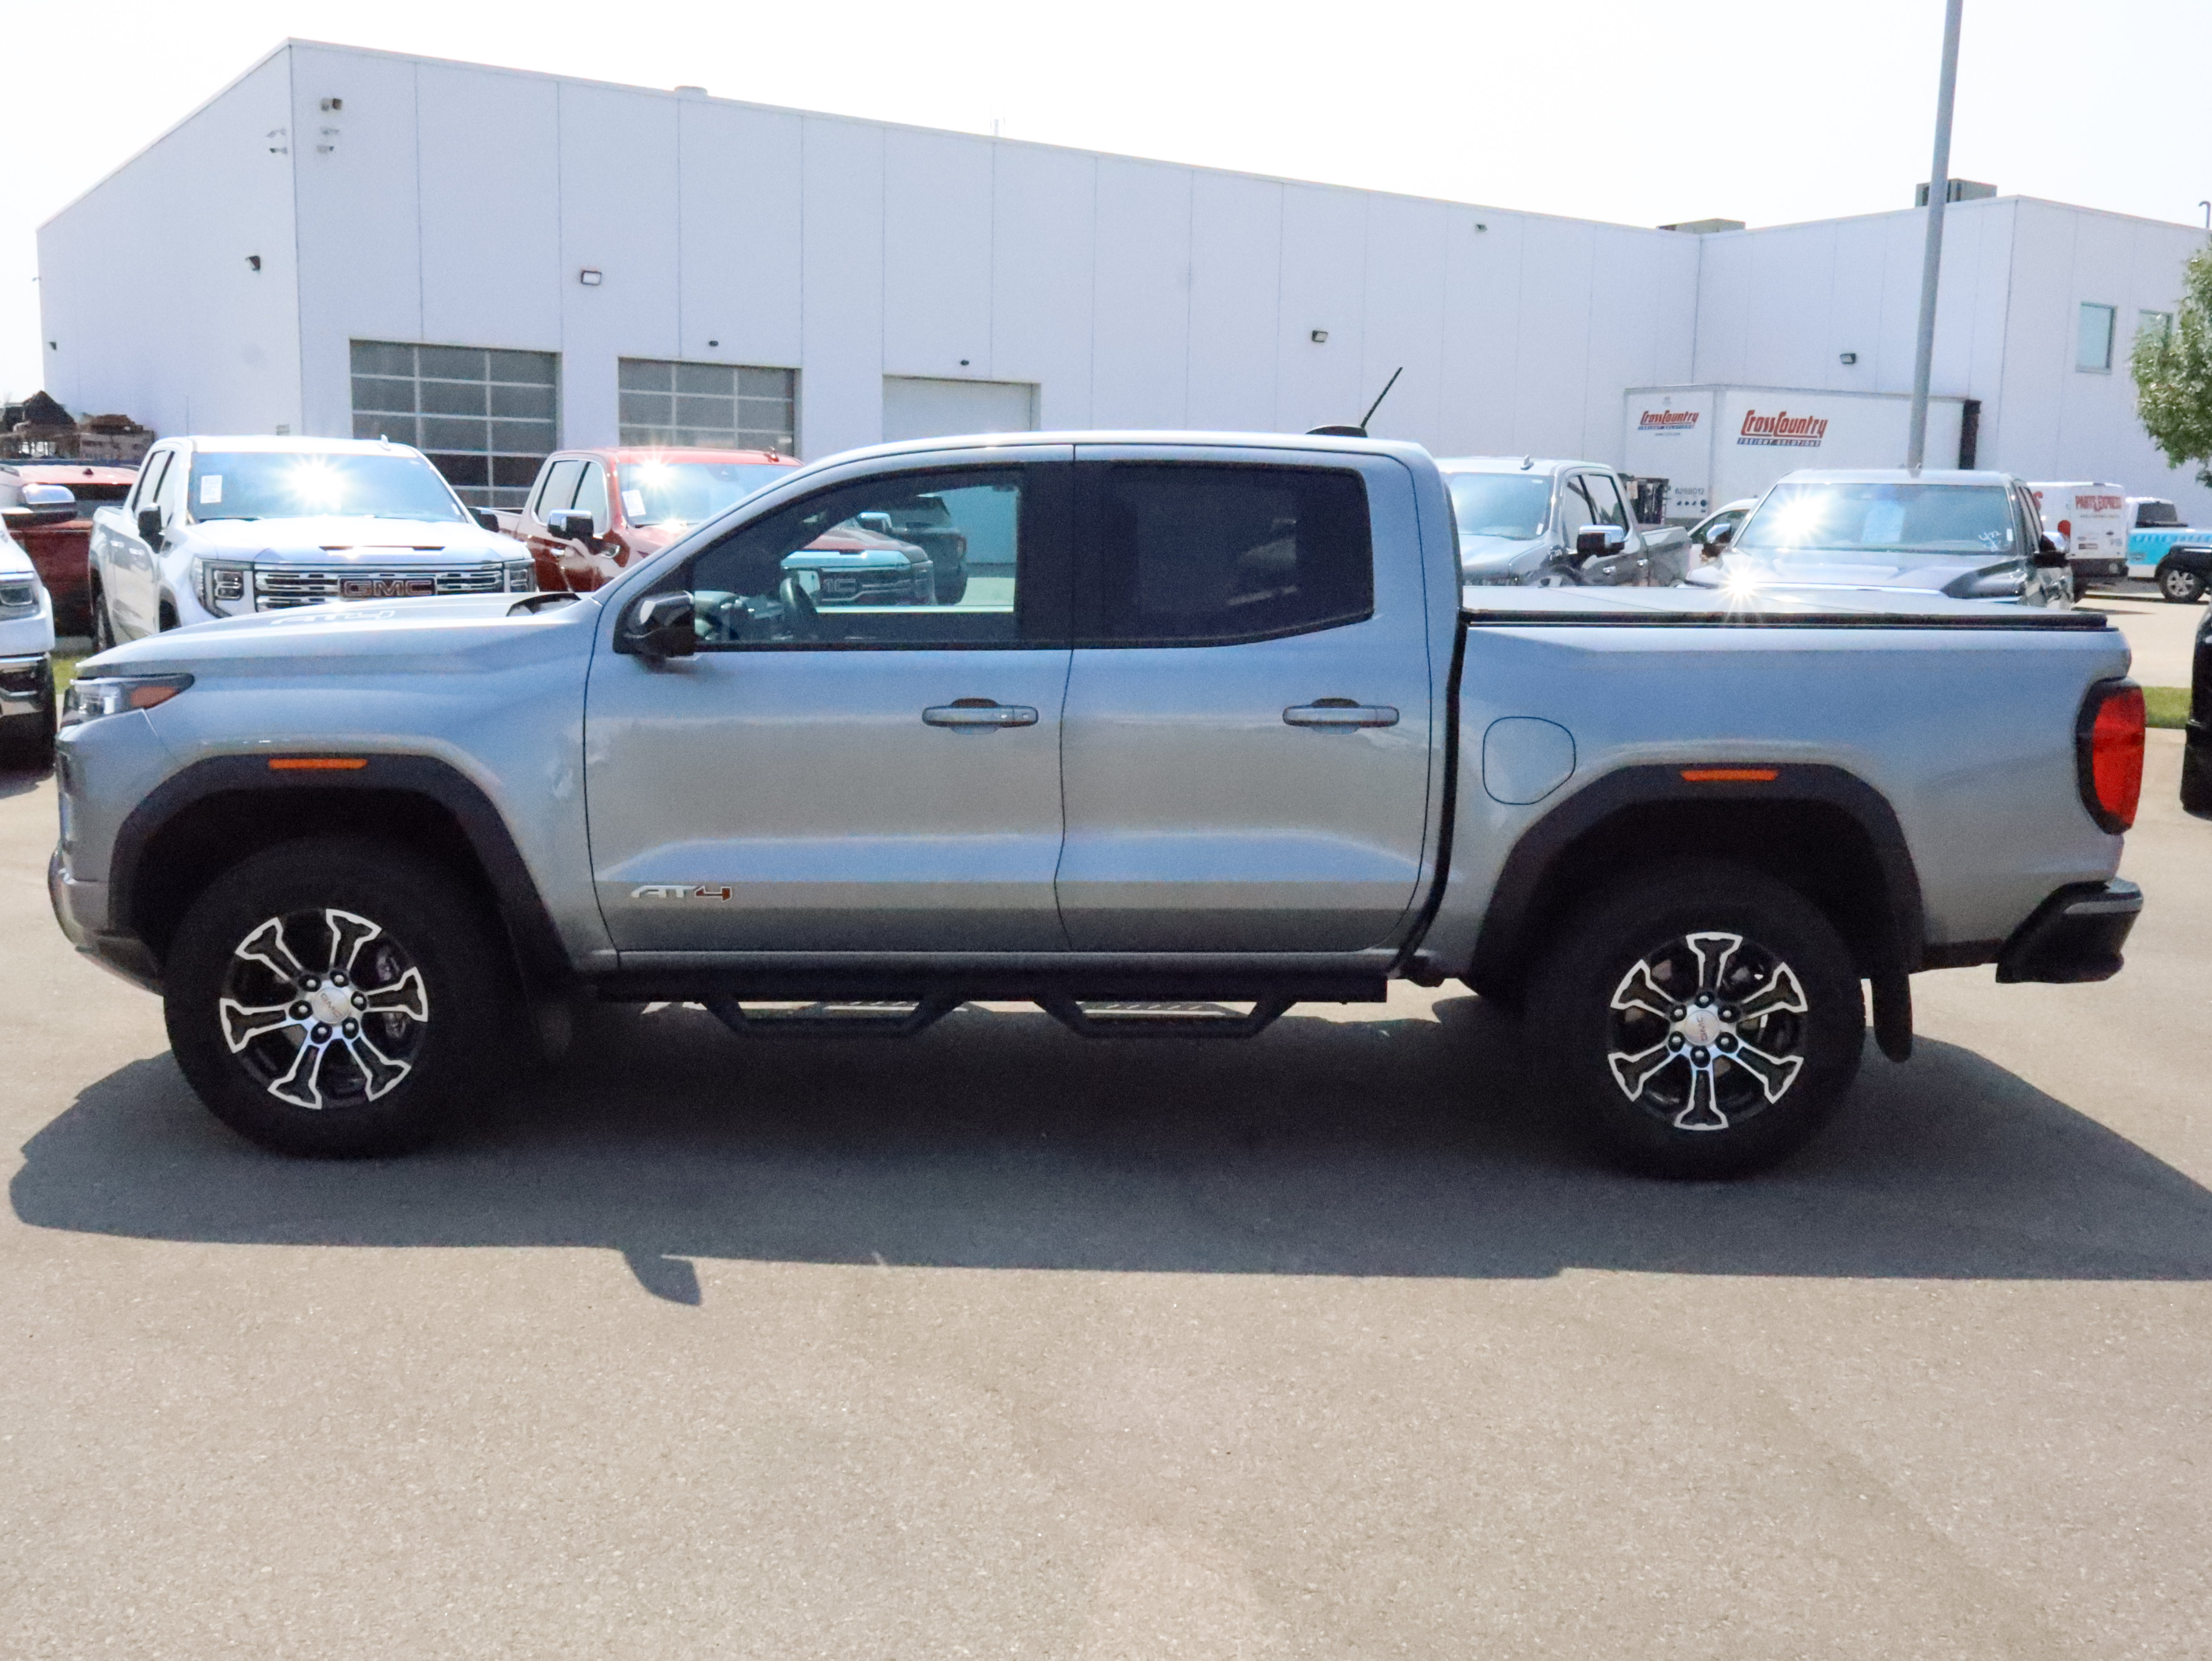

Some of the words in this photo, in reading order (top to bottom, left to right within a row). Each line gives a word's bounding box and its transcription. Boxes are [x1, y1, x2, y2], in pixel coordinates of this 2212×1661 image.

[1741, 410, 1828, 439] CrossCountry
[345, 580, 432, 596] GMC
[631, 885, 732, 902] AT4
